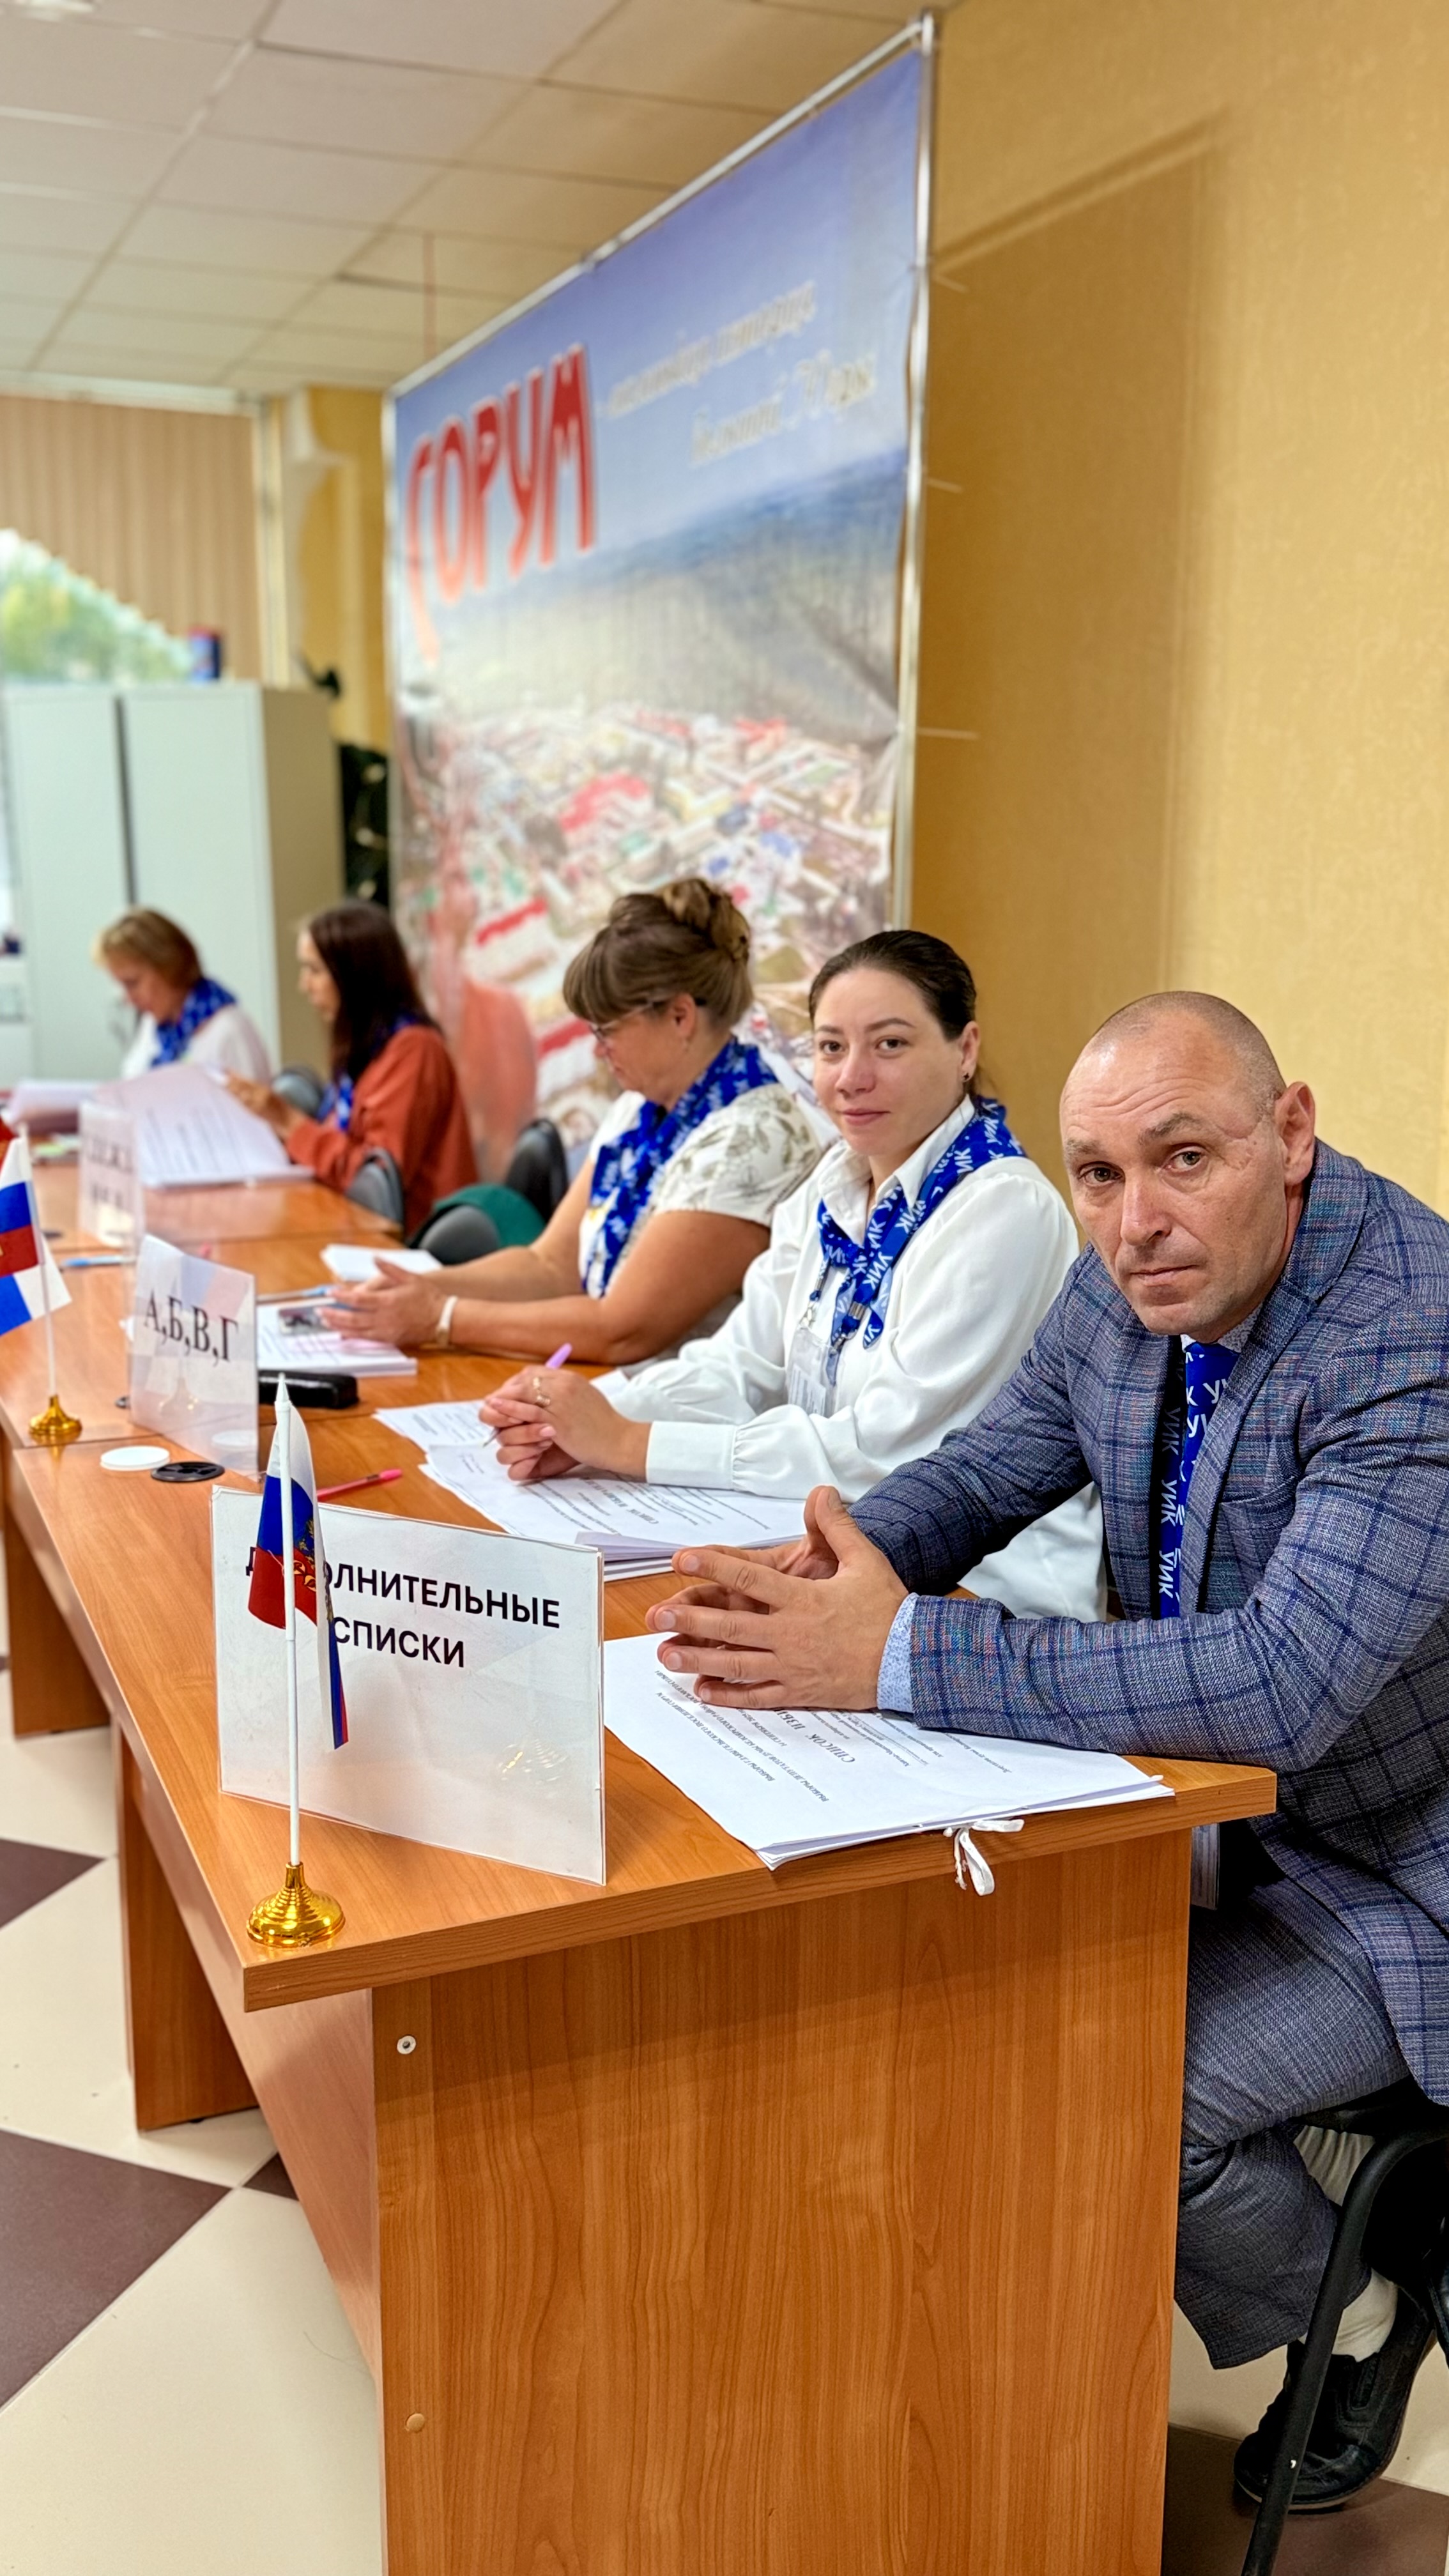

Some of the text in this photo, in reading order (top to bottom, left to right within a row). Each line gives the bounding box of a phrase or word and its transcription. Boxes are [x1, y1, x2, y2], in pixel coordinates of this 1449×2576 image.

[864, 1251, 894, 1290] УИК
[1164, 1407, 1181, 1455] УИК
[1160, 1479, 1177, 1527] УИК
[245, 1546, 560, 1629] ЛНИТЕЛЬНЫЕ
[1158, 1550, 1174, 1598] УИК
[334, 1616, 464, 1668] СПИСКИ
[803, 1733, 857, 1763] СПИСОК
